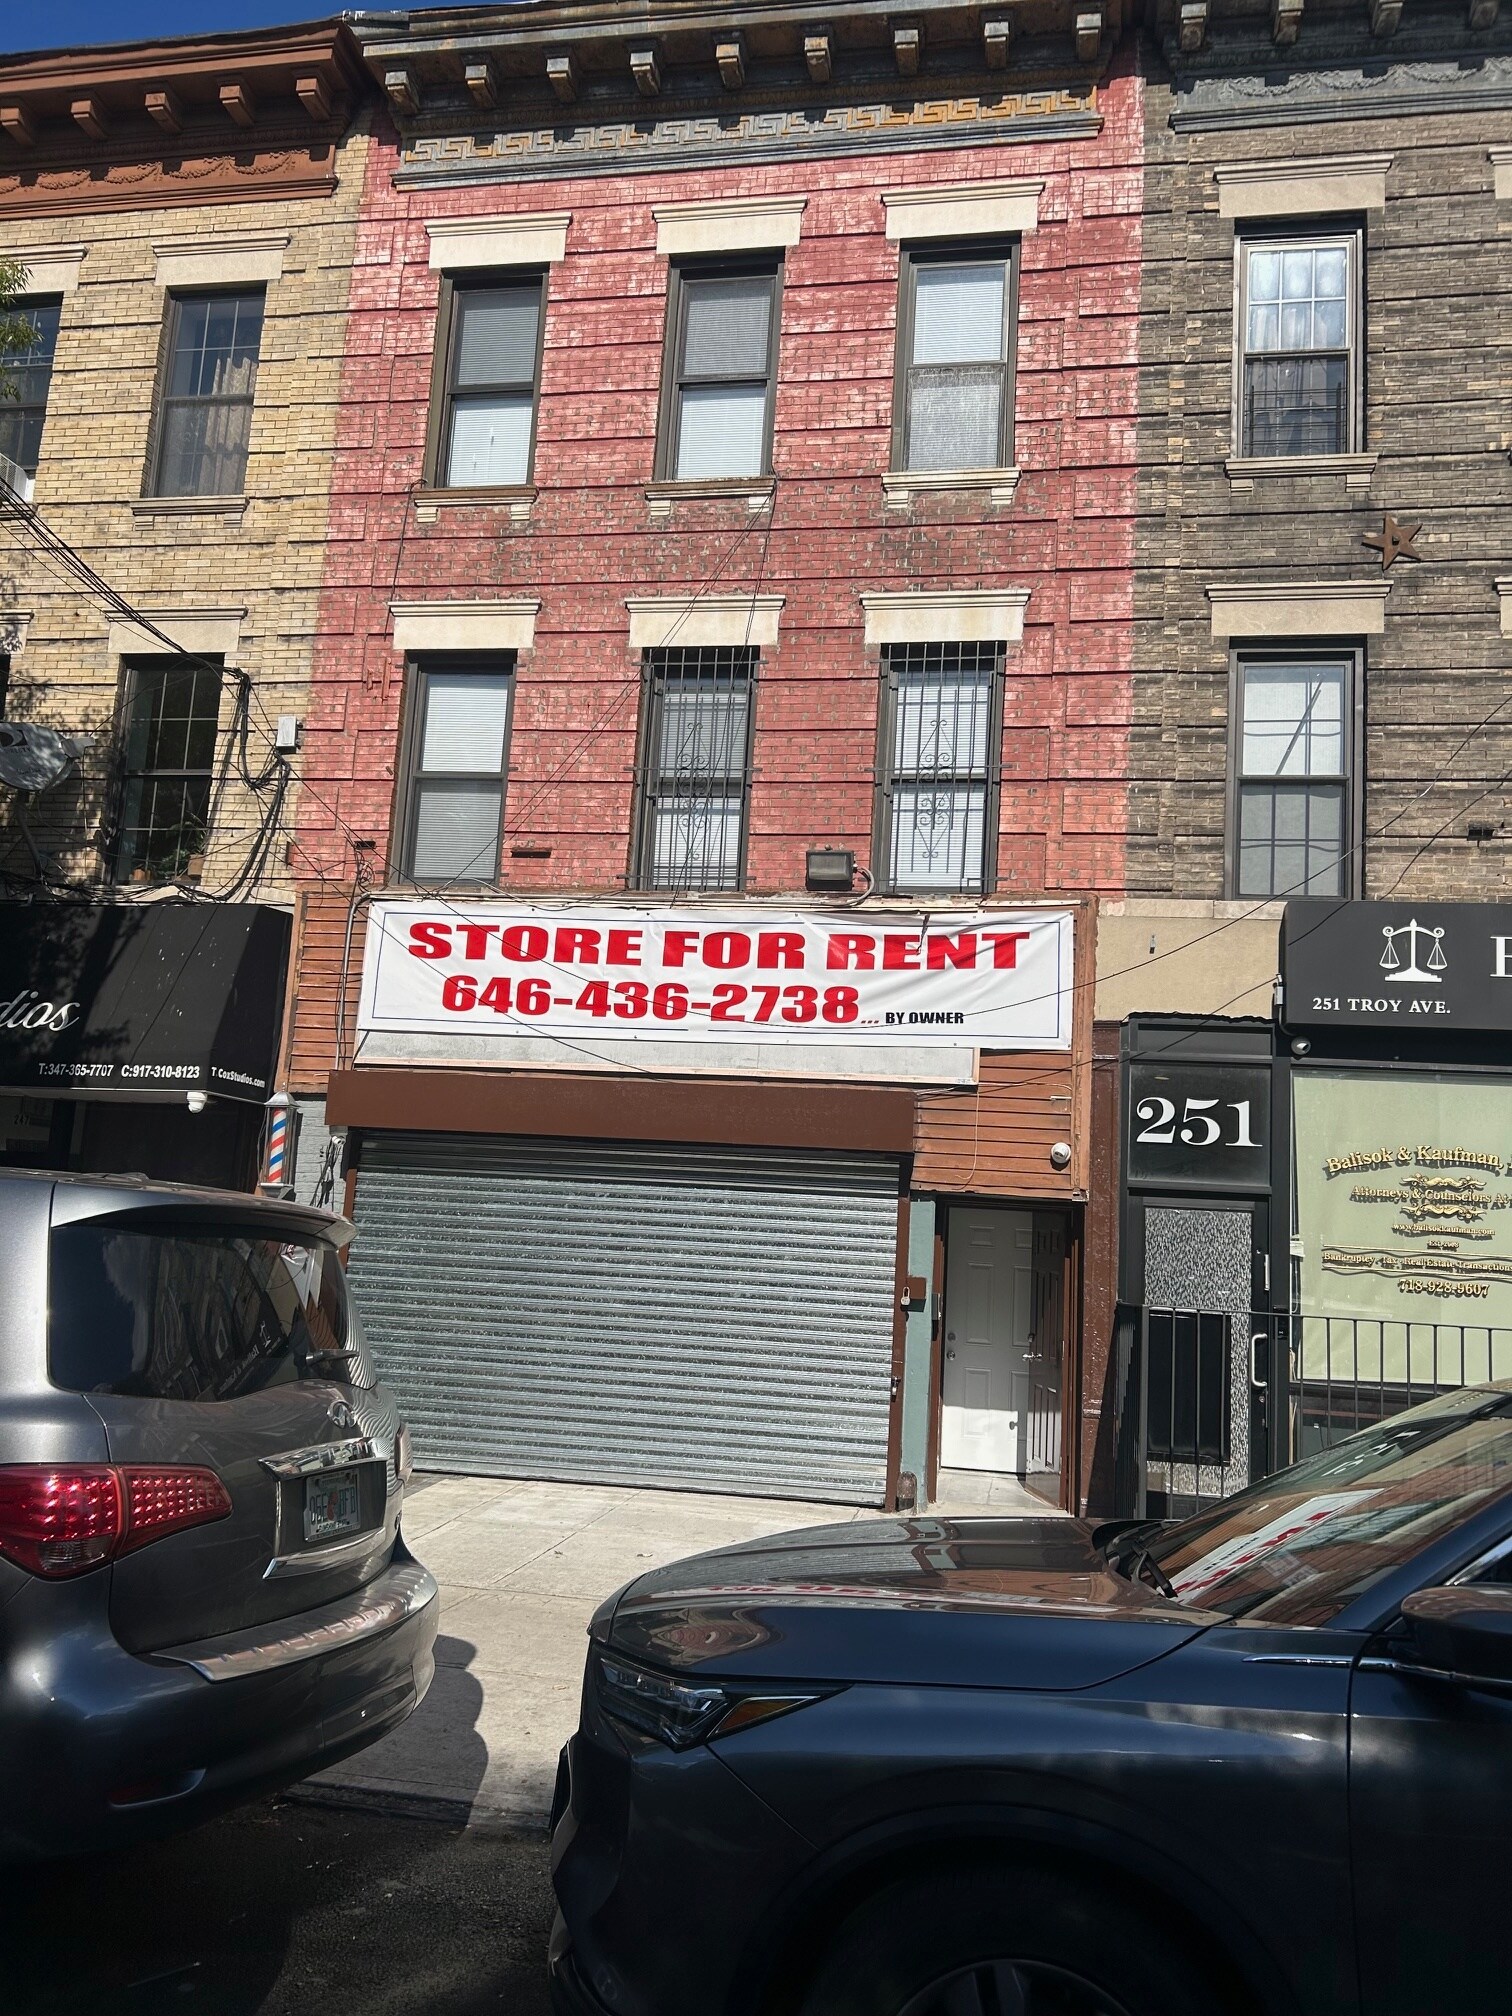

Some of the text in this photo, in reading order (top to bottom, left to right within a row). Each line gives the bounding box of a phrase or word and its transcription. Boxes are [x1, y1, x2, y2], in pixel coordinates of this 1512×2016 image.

[408, 922, 1031, 971] STORE FOR RENT
[1312, 997, 1451, 1014] 251 TROY AVE.
[885, 1012, 905, 1025] BY
[908, 1012, 965, 1024] OWNER
[39, 1062, 201, 1079] T:347-365-7707 C:917-310-8123
[1136, 1096, 1263, 1147] 251
[1325, 1147, 1394, 1173] Balisok
[1397, 1145, 1412, 1161] &
[1416, 1145, 1504, 1170] Kaufman,
[1352, 1185, 1409, 1199] Attorneys
[1411, 1187, 1422, 1199] &
[1425, 1189, 1492, 1203] Counselors
[1398, 1278, 1491, 1297] 718-928-9607
